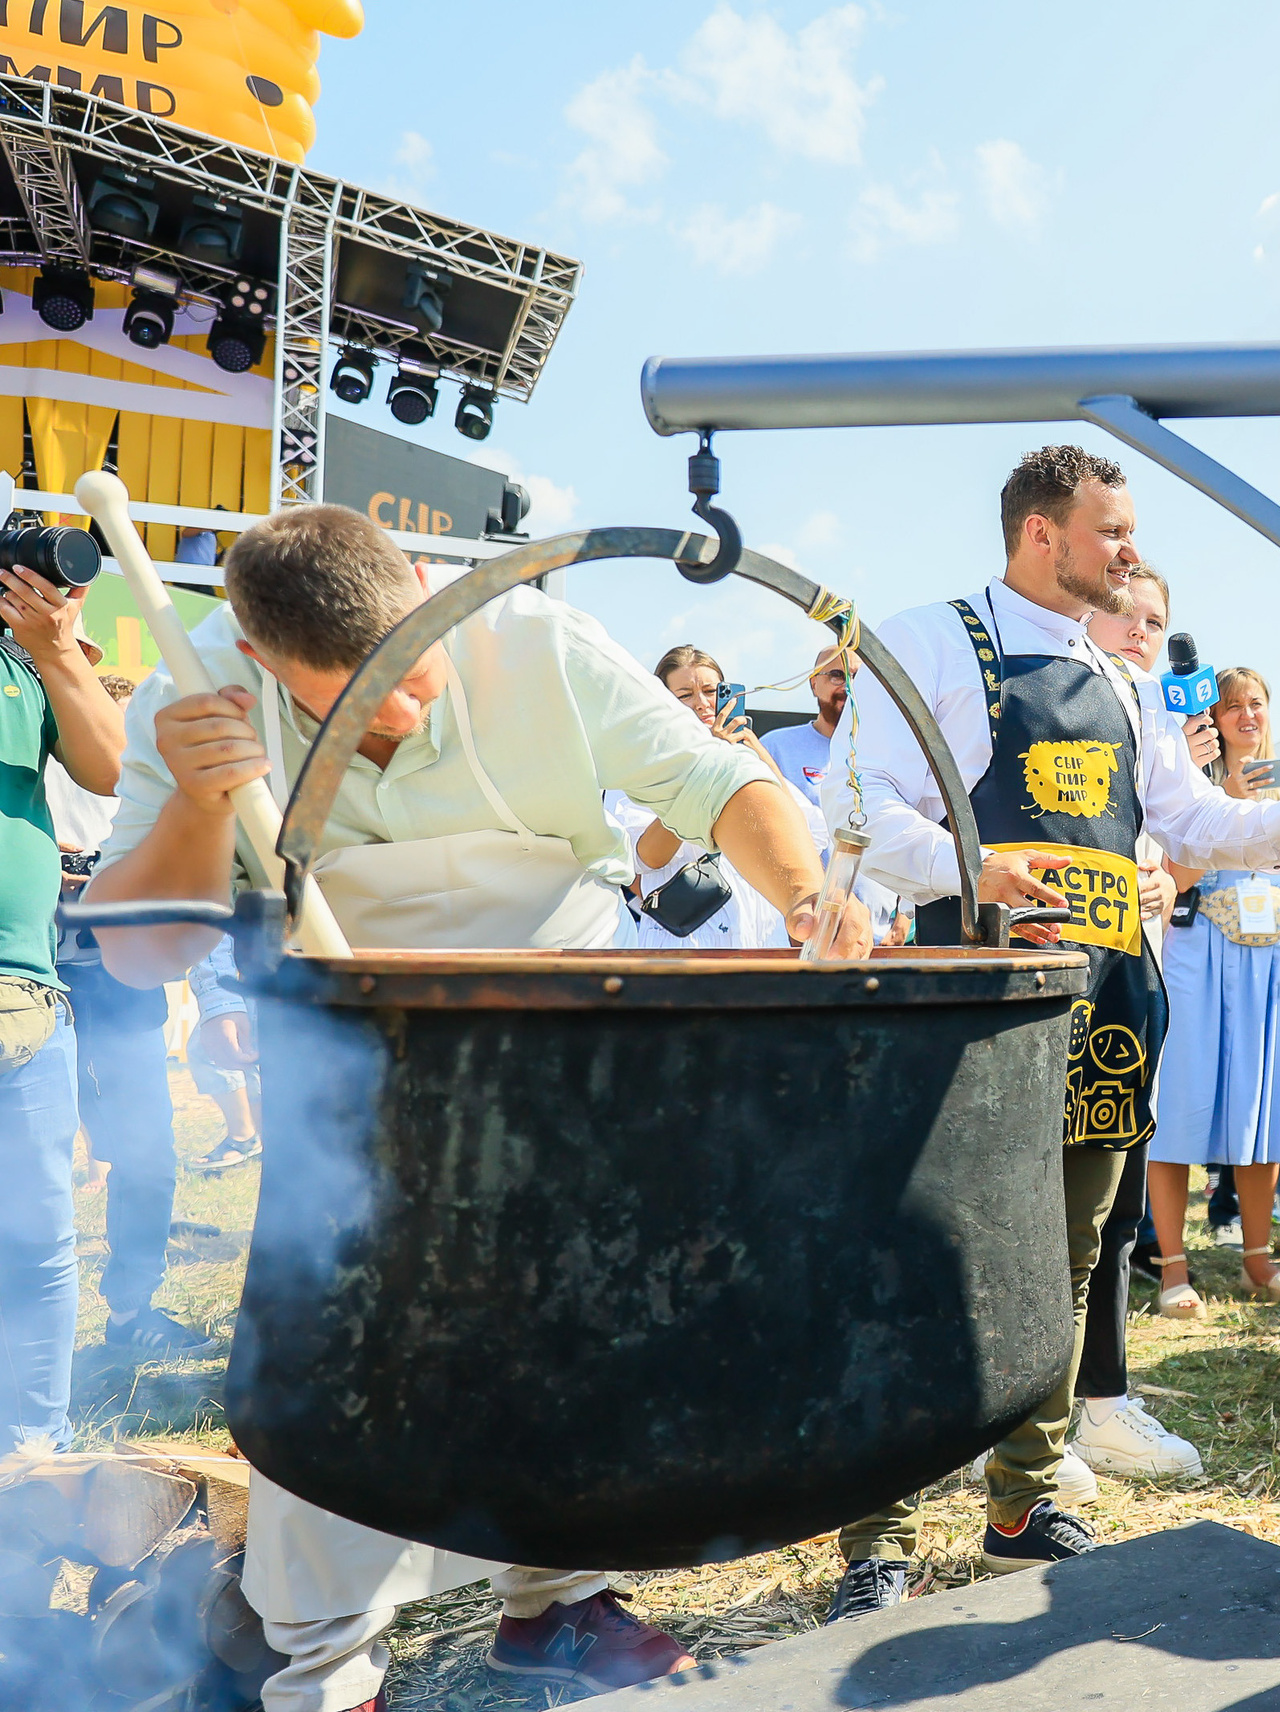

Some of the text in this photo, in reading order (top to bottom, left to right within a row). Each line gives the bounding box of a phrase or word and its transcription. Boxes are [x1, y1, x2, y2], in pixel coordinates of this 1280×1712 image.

[369, 492, 453, 535] СЫР
[1054, 755, 1084, 770] СЫР
[1056, 772, 1087, 786] ПИР
[1057, 789, 1087, 802] МИР
[1032, 867, 1128, 898] АСТРО
